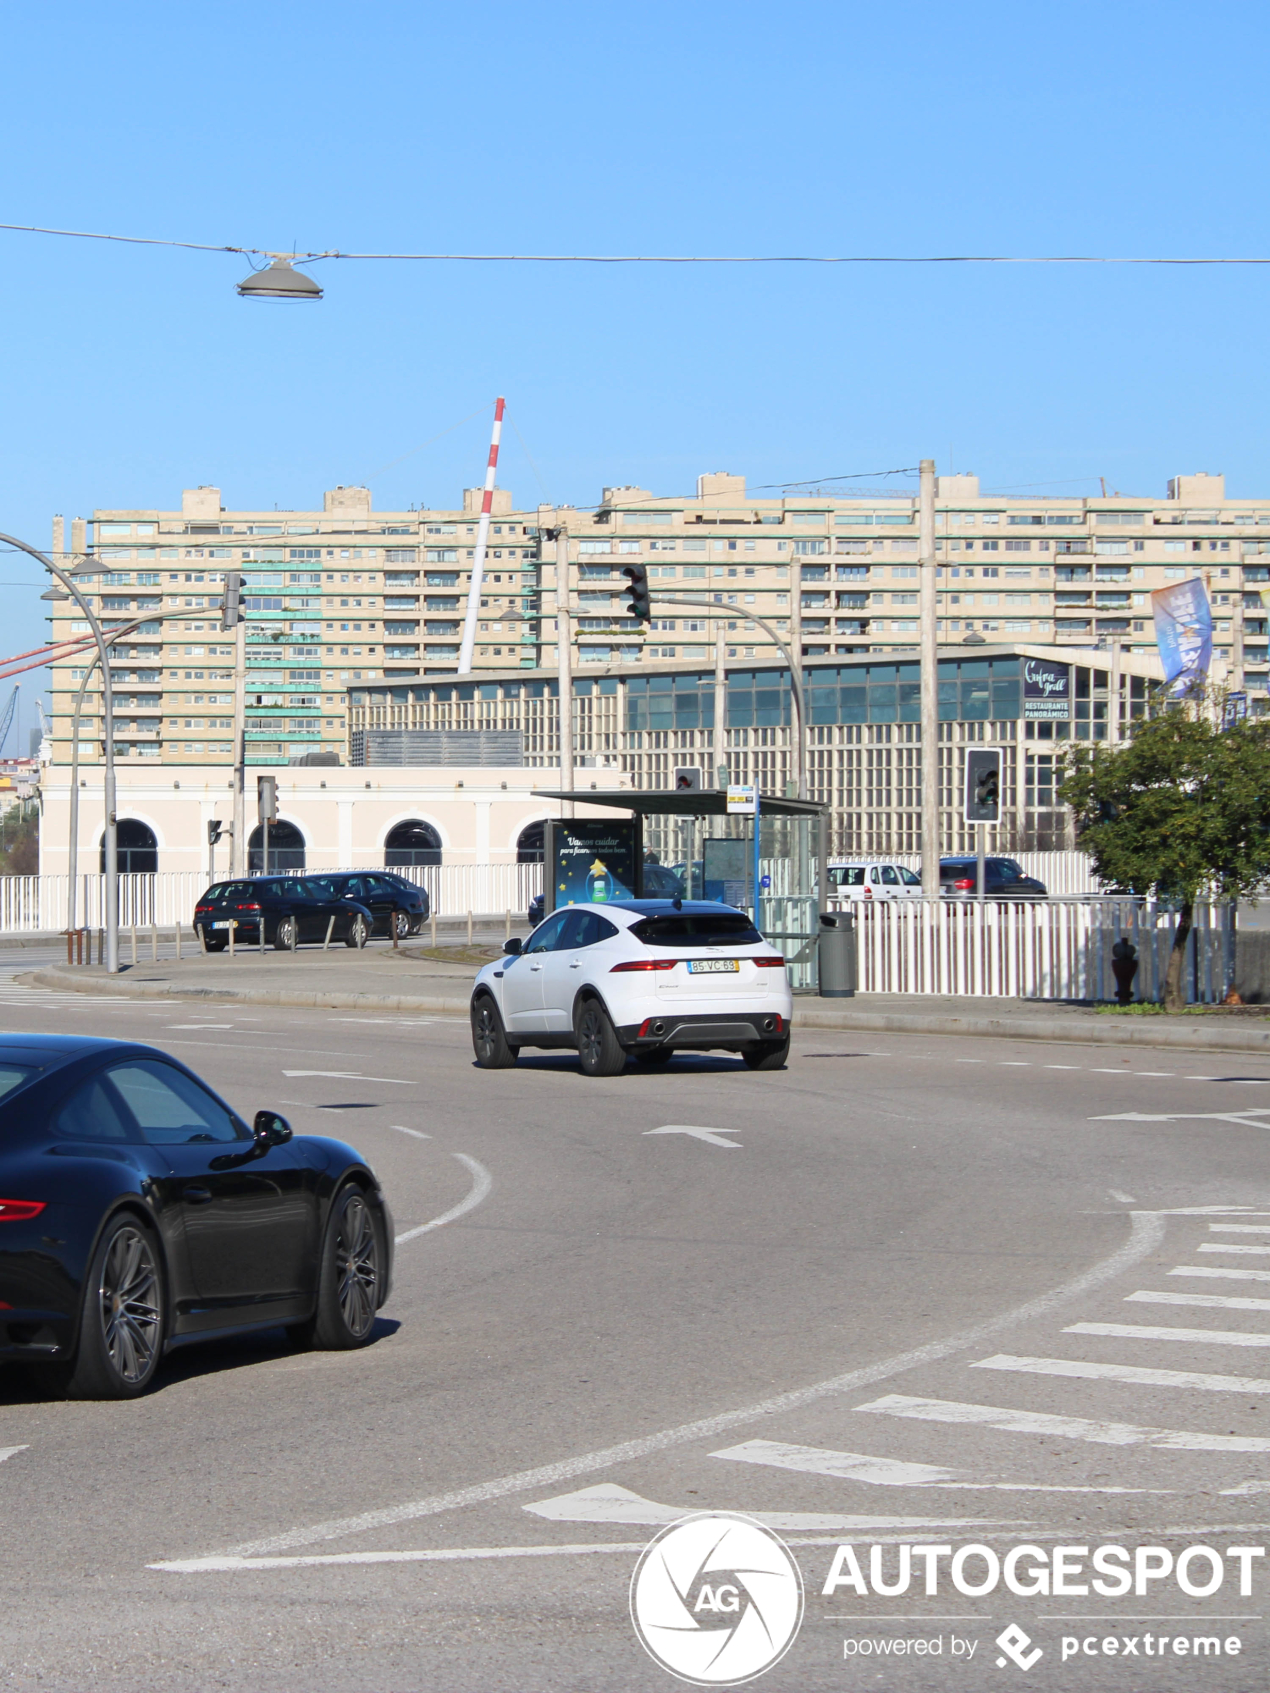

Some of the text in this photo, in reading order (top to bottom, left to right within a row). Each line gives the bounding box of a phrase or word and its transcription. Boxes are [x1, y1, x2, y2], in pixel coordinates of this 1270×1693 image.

[1025, 661, 1055, 688] Cufra
[1025, 702, 1069, 710] RESTAURANTE
[567, 837, 619, 846] Vamos cuidar
[560, 848, 574, 857] para
